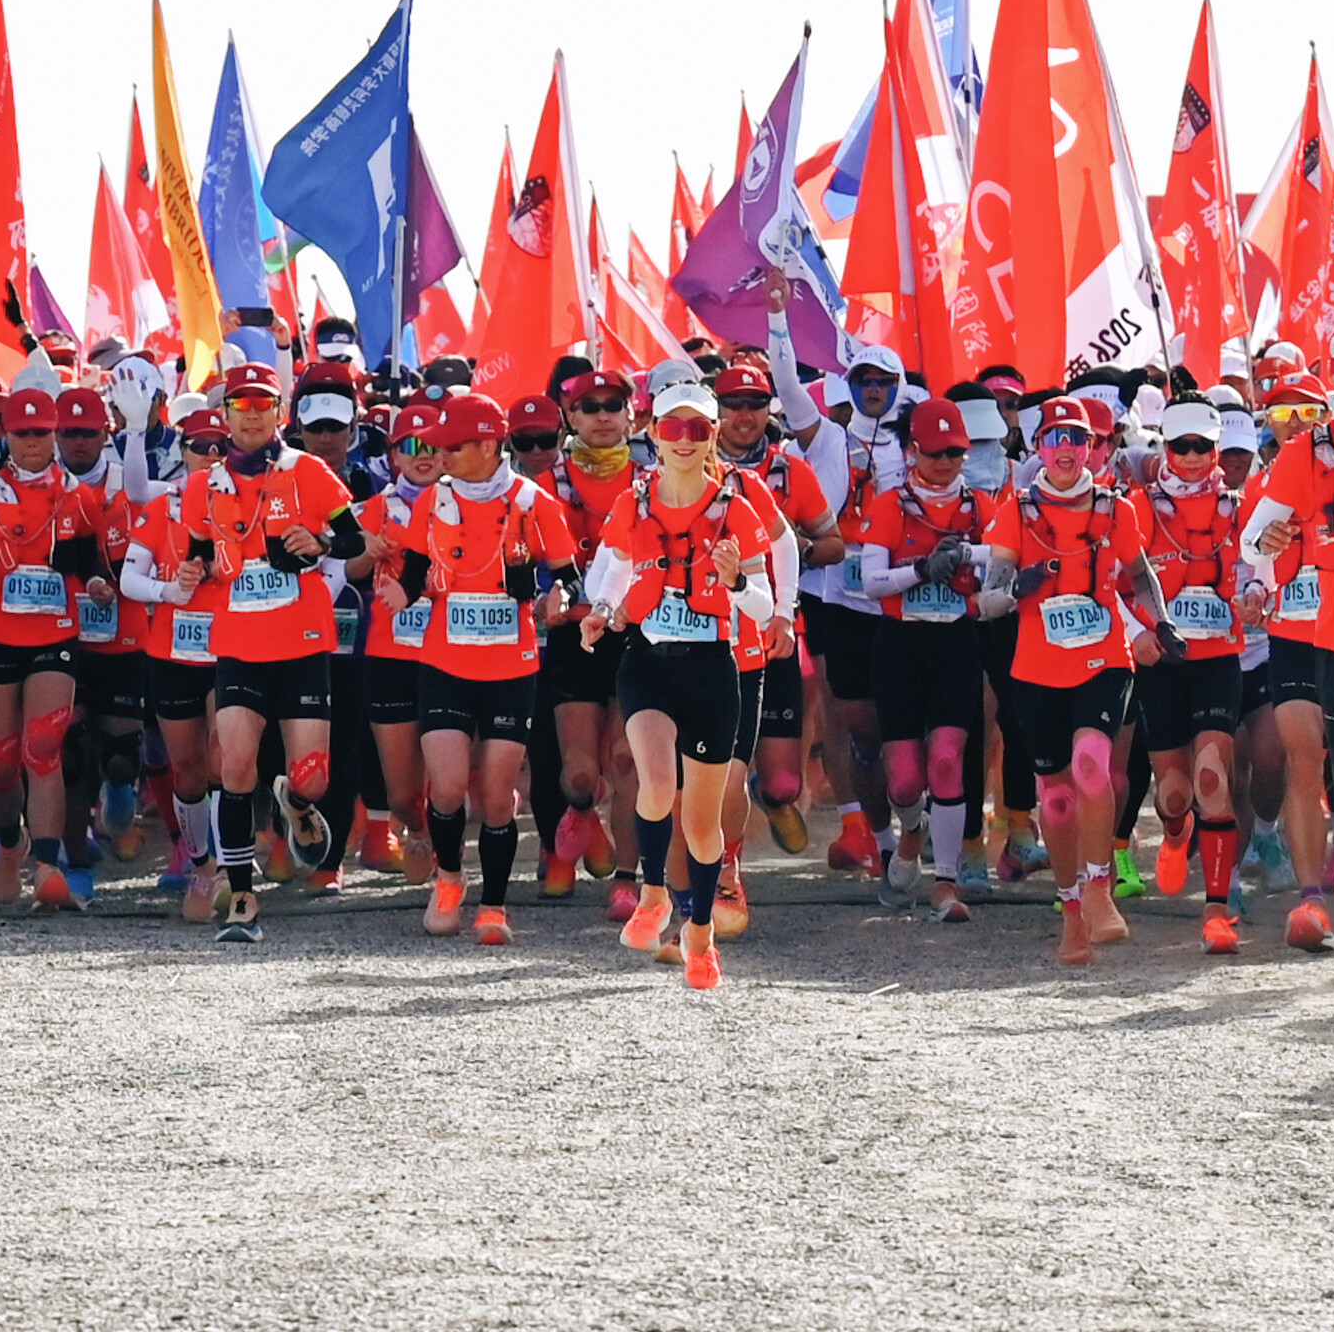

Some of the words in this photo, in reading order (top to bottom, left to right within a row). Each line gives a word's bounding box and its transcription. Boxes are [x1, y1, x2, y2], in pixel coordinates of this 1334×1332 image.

[7, 577, 32, 596] 01S
[258, 572, 290, 590] 1051
[906, 585, 931, 603] 01S
[83, 606, 113, 624] 1050
[451, 607, 476, 625] 01S
[482, 608, 513, 625] 1035
[1174, 600, 1200, 618] 01S
[398, 610, 424, 628] 01S
[1048, 611, 1076, 631] 01S
[178, 624, 202, 640] 01S
[337, 622, 352, 638] 59
[696, 740, 707, 755] 6
